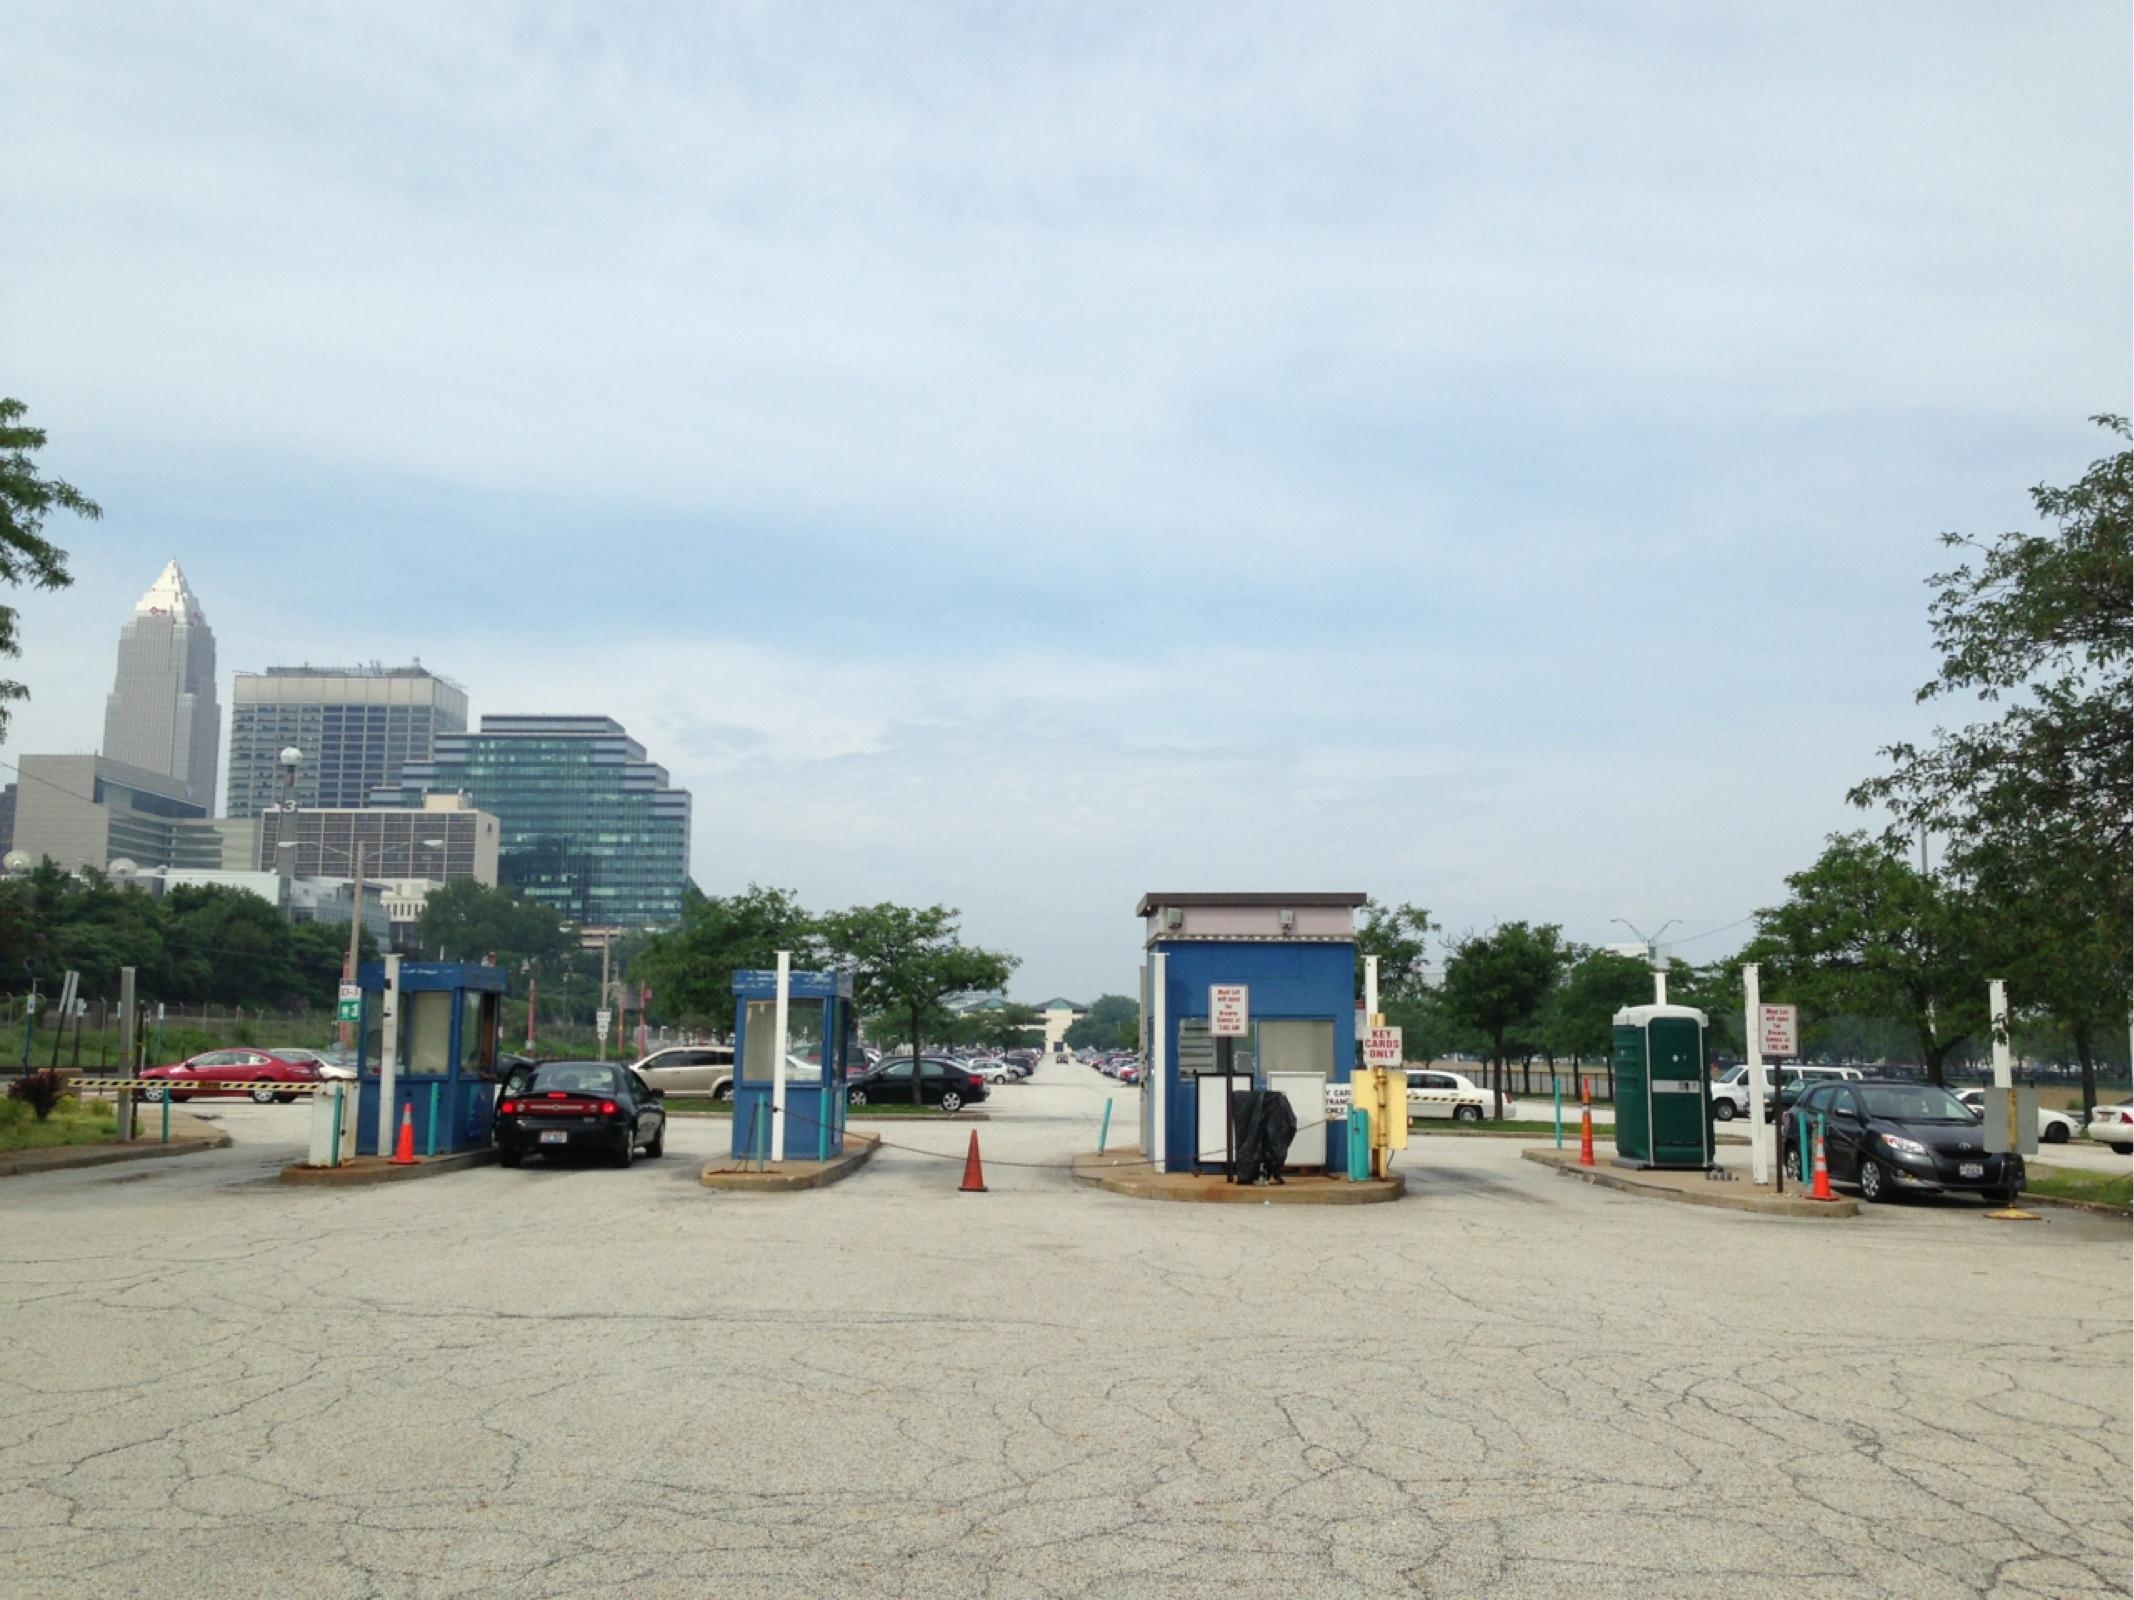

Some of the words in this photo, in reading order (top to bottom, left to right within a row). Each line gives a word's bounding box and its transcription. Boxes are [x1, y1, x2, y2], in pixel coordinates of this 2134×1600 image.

[1371, 1029, 1392, 1039] KEY
[1364, 1039, 1400, 1049] CARDS
[1369, 1049, 1395, 1059] ONLY
